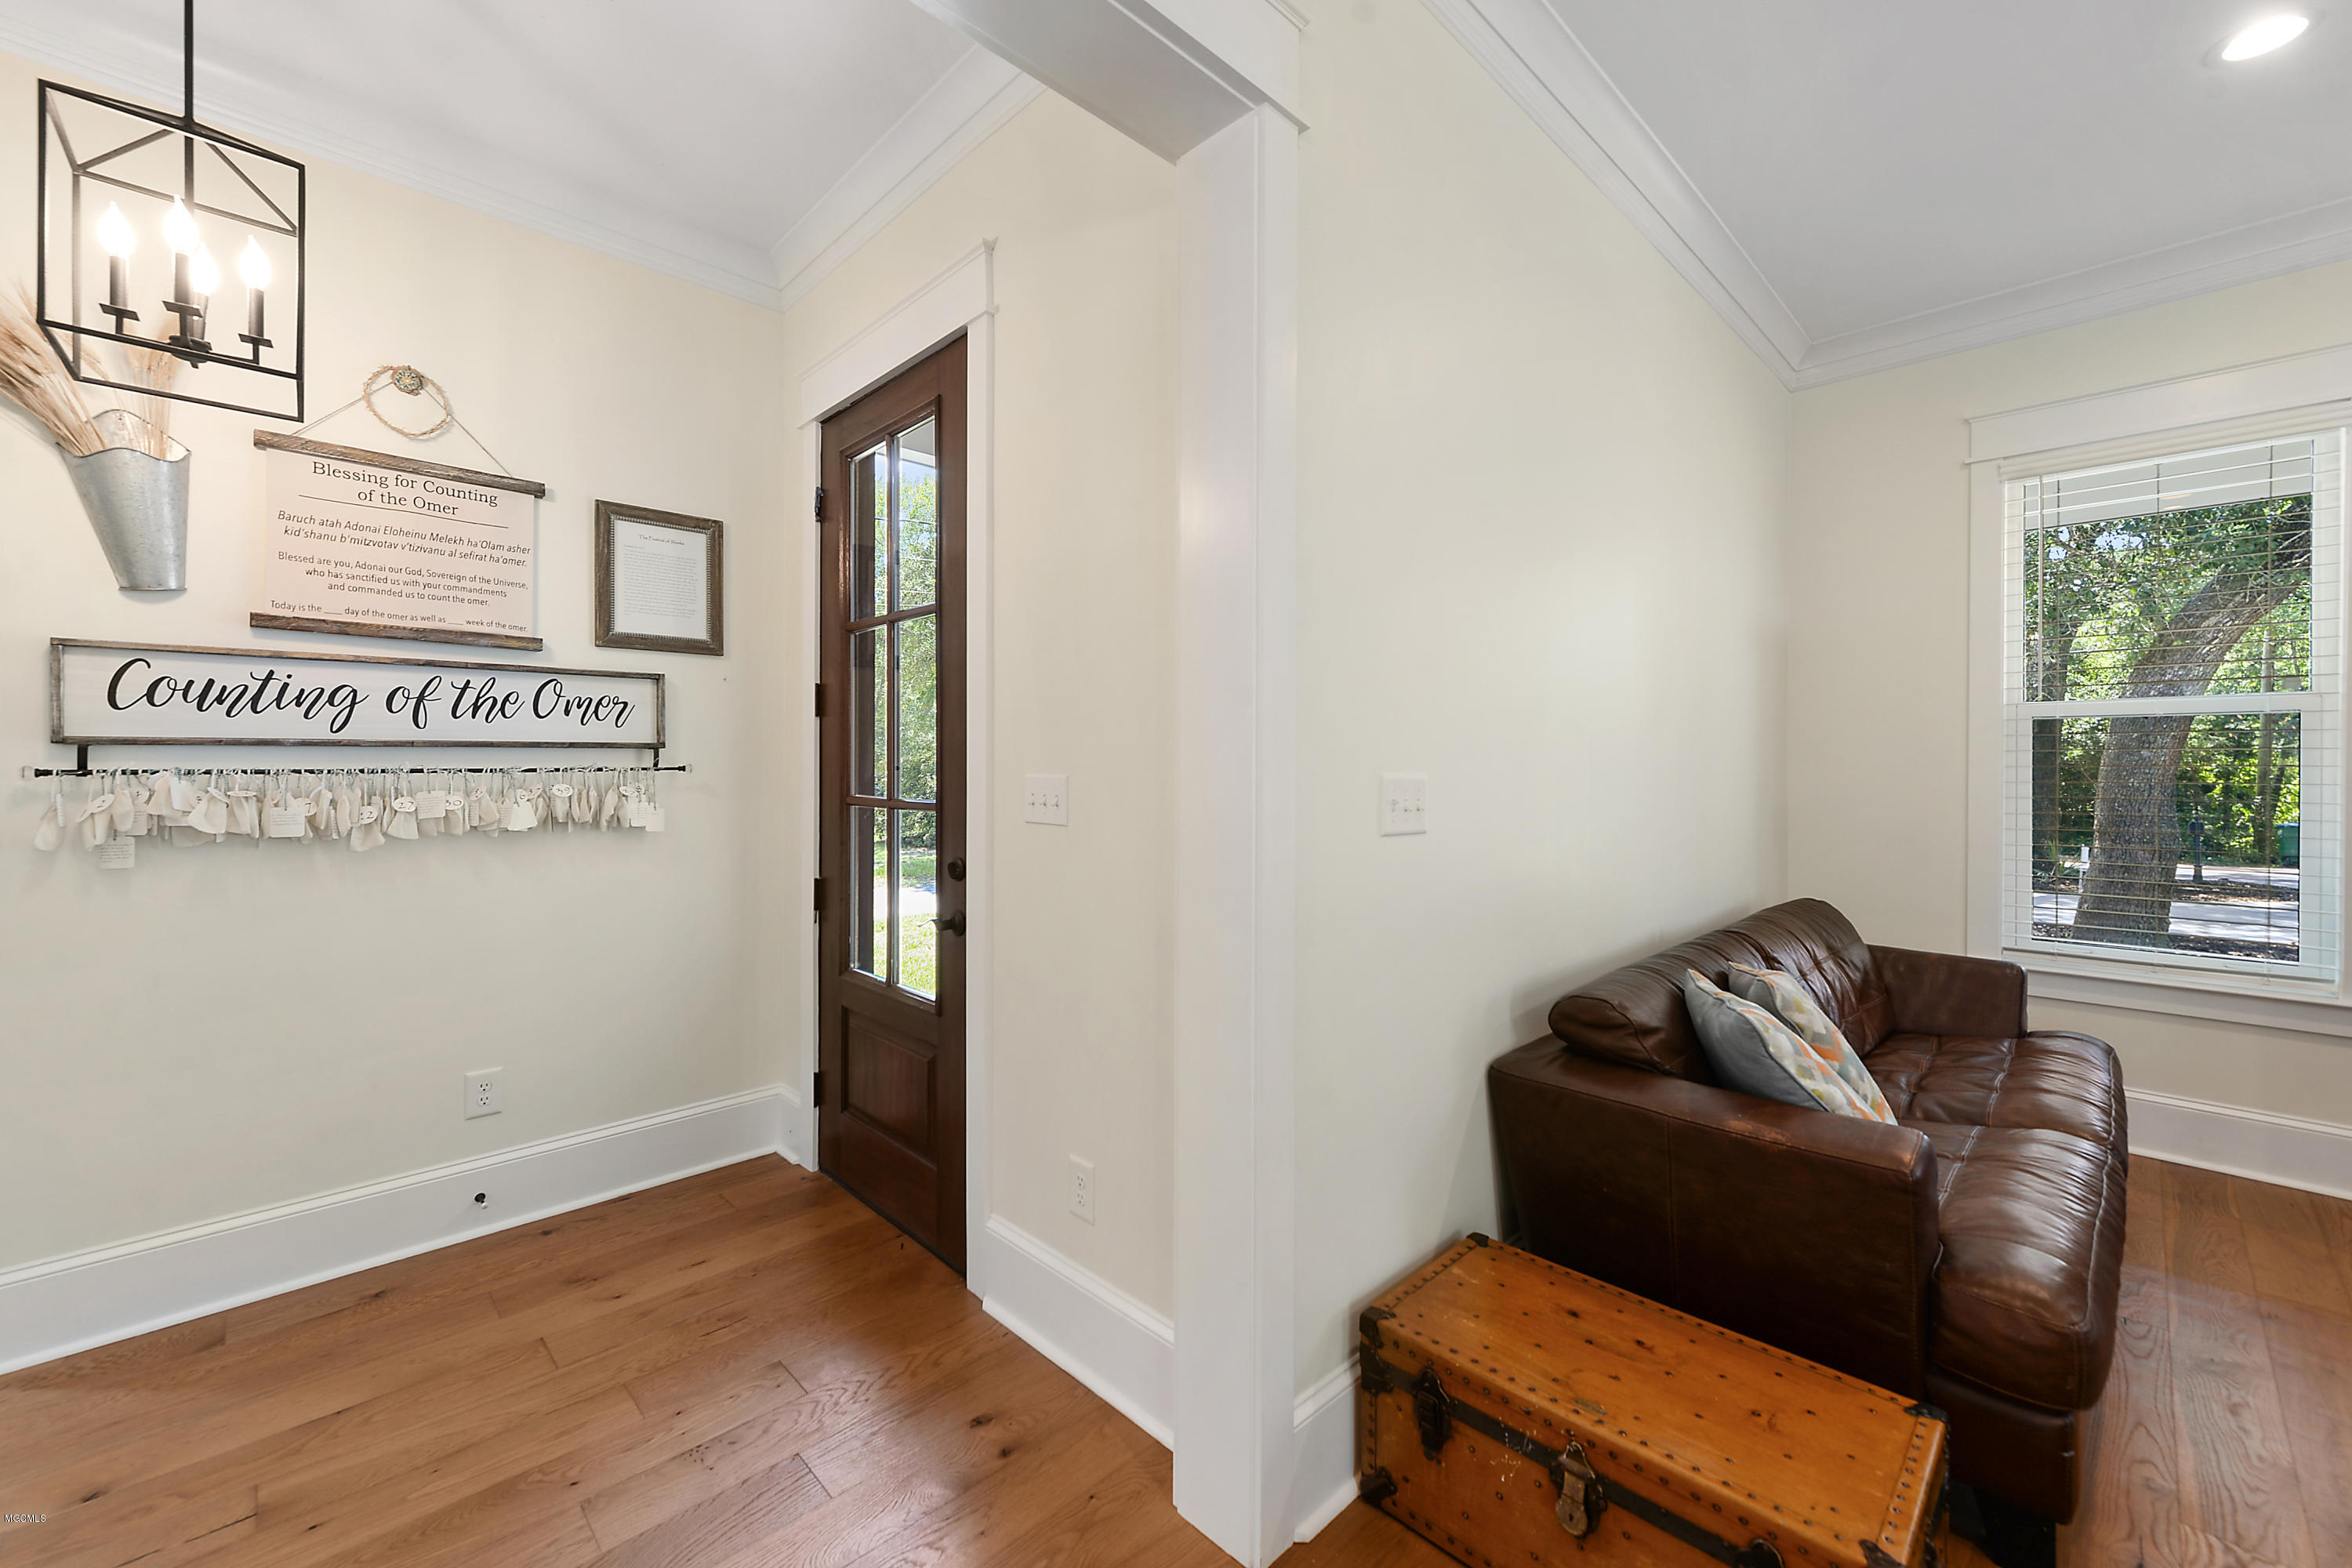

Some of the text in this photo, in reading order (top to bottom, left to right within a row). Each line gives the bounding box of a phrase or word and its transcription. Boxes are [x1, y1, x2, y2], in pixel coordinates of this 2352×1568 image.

[313, 461, 498, 507] Blessing for Counting
[358, 490, 459, 515] of the Omer
[278, 510, 315, 524] Baruch
[319, 519, 341, 528] atah
[344, 521, 381, 534] Adonai
[383, 526, 426, 540] Eloheinu
[429, 532, 464, 546] Melekh
[506, 544, 531, 554] asher
[278, 551, 314, 564] Blessed
[334, 560, 353, 569] you,
[355, 561, 386, 572] Adonai
[405, 567, 424, 577] God,
[426, 569, 466, 583] Sovereign
[478, 575, 492, 585] the
[448, 549, 457, 557] al
[459, 551, 487, 562] sefirat
[305, 568, 325, 577] who
[328, 569, 343, 579] has
[346, 572, 388, 584] sanctified
[402, 579, 420, 587] with
[423, 582, 441, 590] your
[443, 583, 507, 597] commandments
[347, 585, 403, 597] commanded
[427, 593, 450, 602] count
[452, 594, 466, 604] the
[270, 600, 296, 612] Today
[299, 603, 306, 612] is
[307, 604, 322, 612] the
[344, 607, 360, 617] day
[372, 609, 386, 618] the
[387, 612, 408, 621] omer
[107, 658, 636, 734] Counting of the Omer
[397, 800, 414, 811] 27
